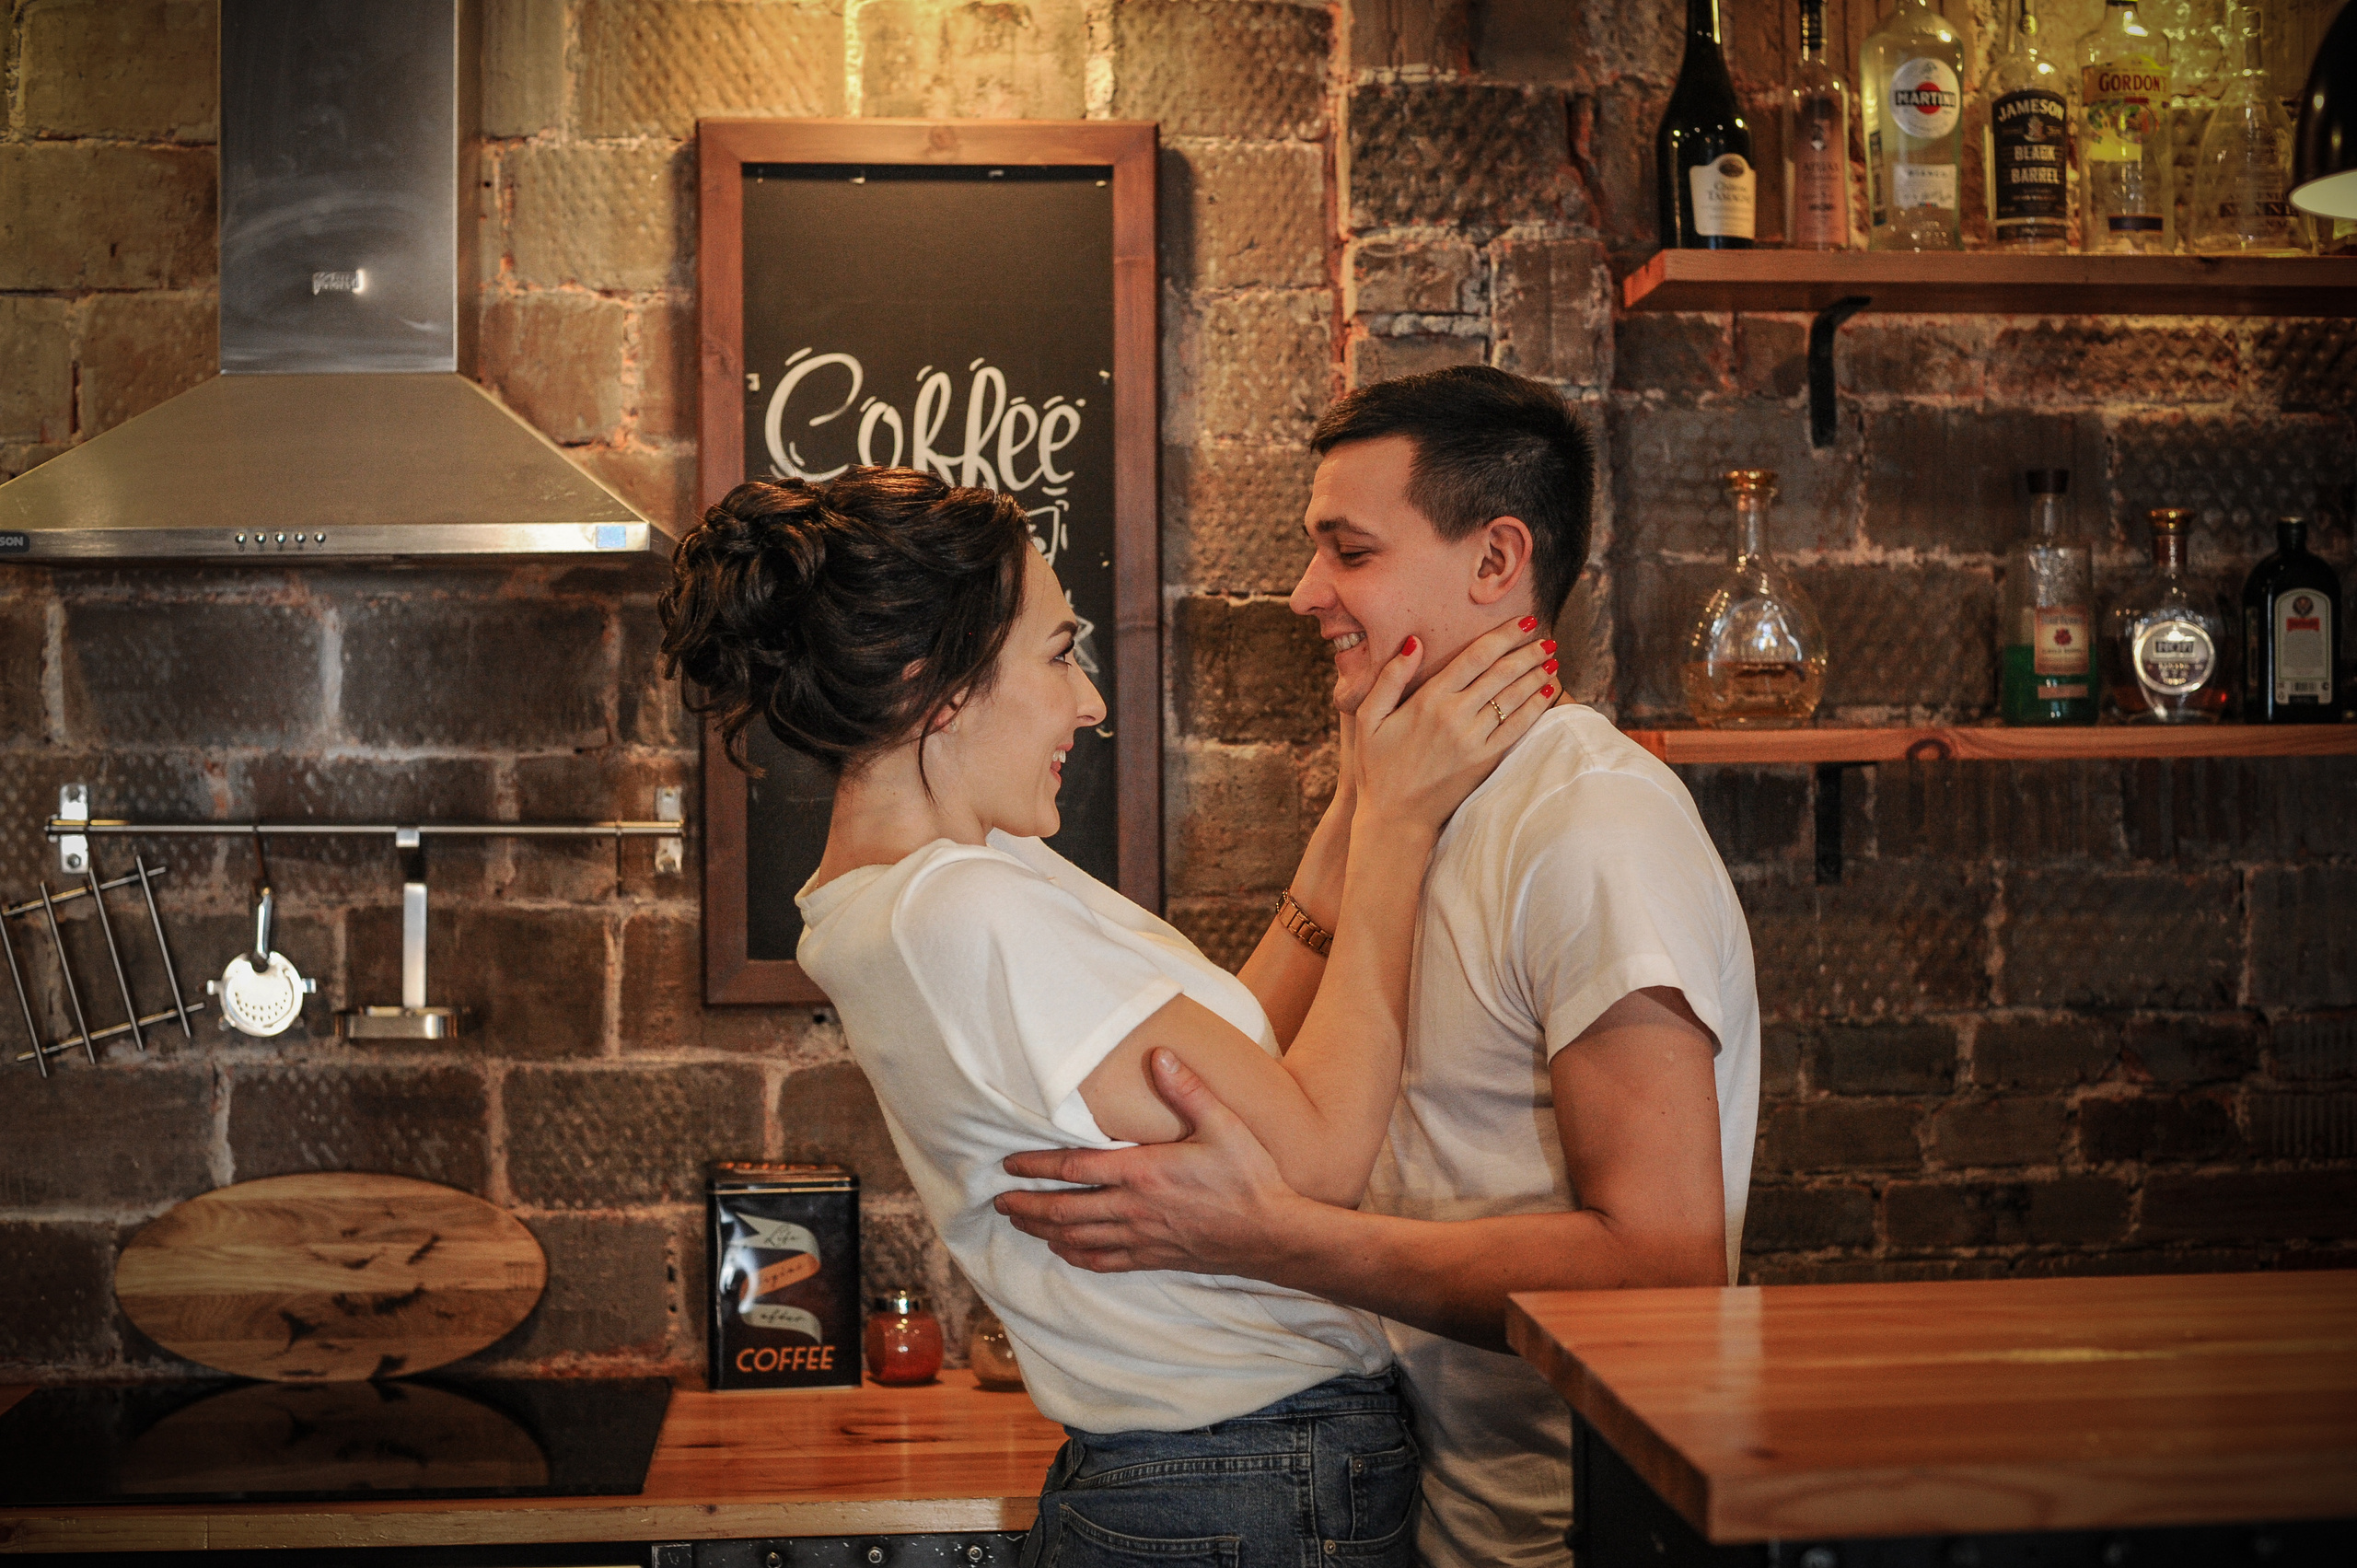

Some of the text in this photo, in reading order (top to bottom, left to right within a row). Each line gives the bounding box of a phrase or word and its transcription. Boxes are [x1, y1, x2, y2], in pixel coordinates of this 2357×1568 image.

[1895, 89, 1956, 108] MARTINI
[1997, 98, 2065, 123] JAMESON
[2014, 145, 2057, 162] BLACK
[2010, 167, 2061, 184] BARREL
[764, 348, 1084, 494] Coffee
[736, 1344, 836, 1374] COFFEE
